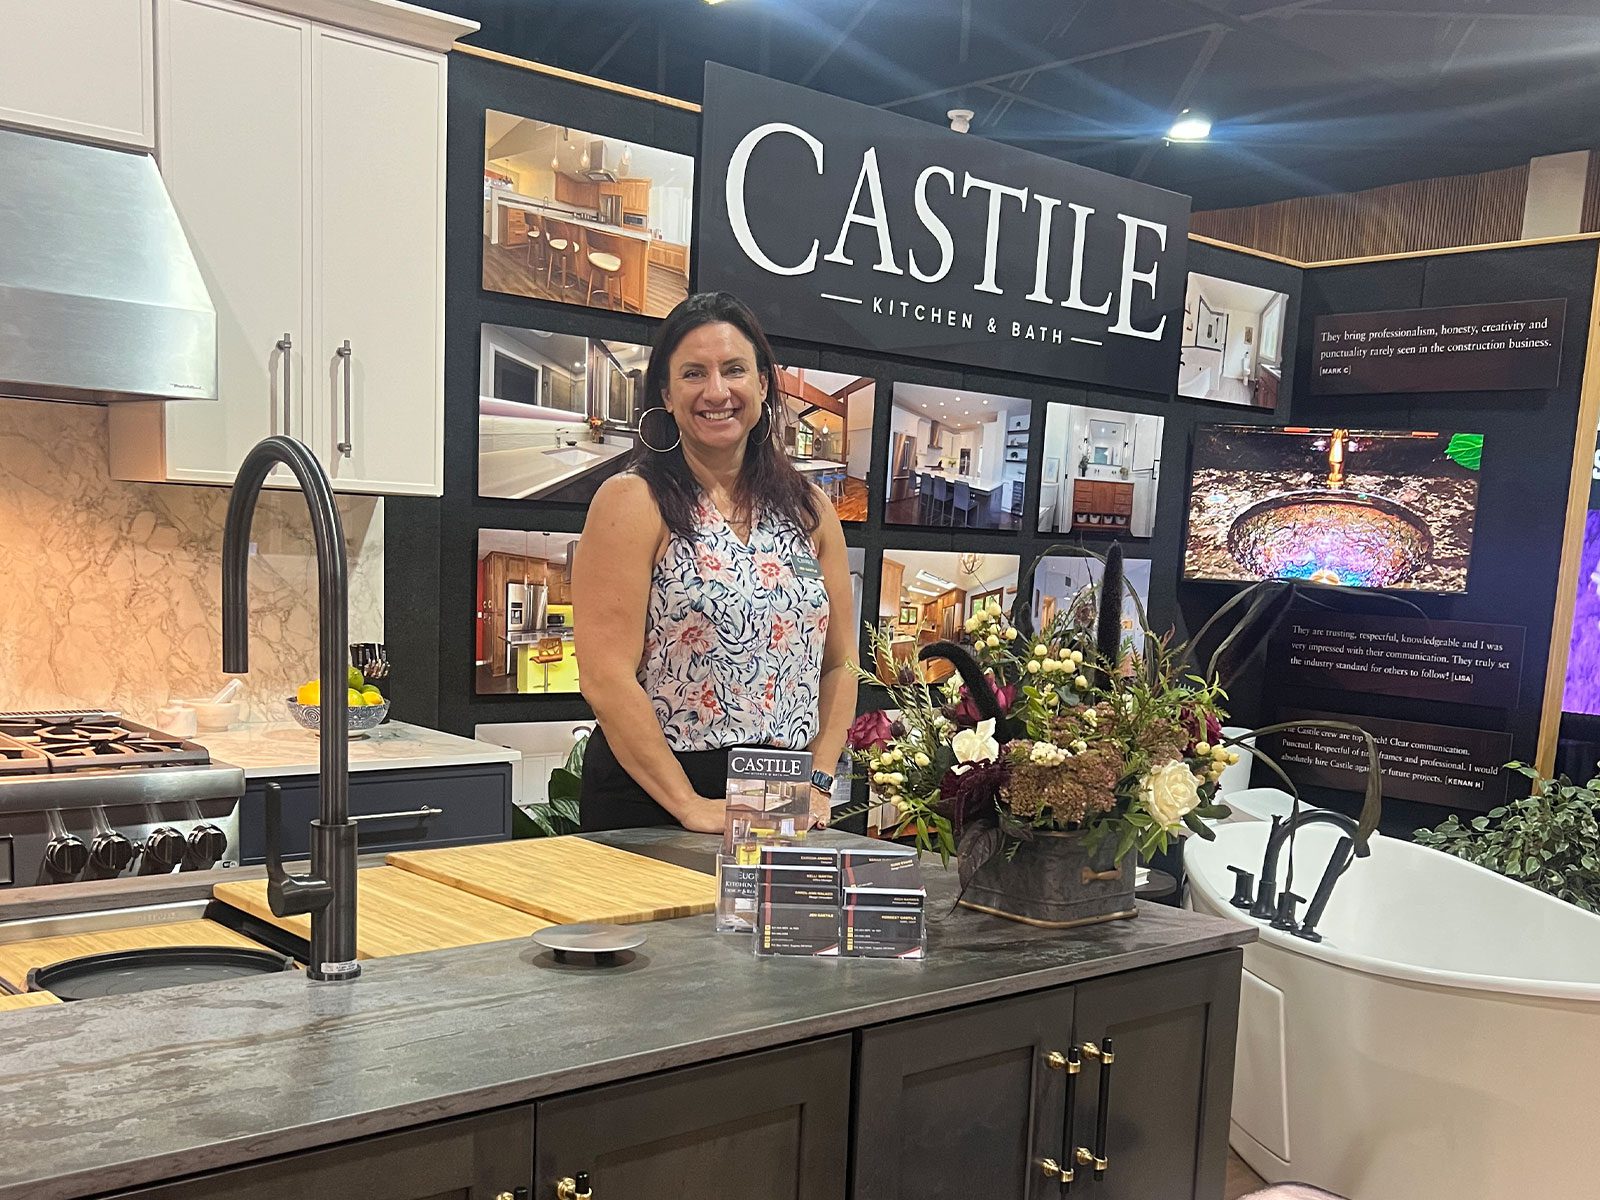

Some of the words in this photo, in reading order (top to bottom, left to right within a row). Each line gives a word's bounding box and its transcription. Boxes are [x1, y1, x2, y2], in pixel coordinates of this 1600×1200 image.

[725, 122, 1167, 342] CASTILE
[873, 296, 973, 329] KITCHEN
[987, 317, 997, 333] &
[1011, 321, 1062, 344] BATH
[1320, 332, 1341, 343] They
[1344, 330, 1366, 342] bring
[1368, 325, 1438, 342] professionalism,
[1441, 324, 1478, 336] honesty,
[1481, 320, 1526, 332] creativity
[1528, 317, 1548, 329] and
[1320, 346, 1367, 360] punctuality
[1370, 345, 1395, 357] rarely
[1397, 346, 1416, 355] seen
[1418, 344, 1428, 353] in
[1430, 342, 1445, 353] the
[1447, 339, 1505, 352] construction
[1509, 337, 1552, 349] business.
[1320, 366, 1342, 376] [MARK
[1292, 625, 1310, 636] They
[1326, 630, 1357, 640] trusting,
[1360, 632, 1399, 643] respectful,
[1401, 634, 1460, 648] knowledgeable
[1462, 640, 1478, 649] and
[1480, 641, 1485, 650] I
[1486, 643, 1503, 651] was
[1291, 643, 1306, 651] very
[1308, 644, 1345, 654] impressed
[1347, 646, 1364, 655] with
[1366, 647, 1384, 657] their
[1385, 650, 1450, 664] communication.
[1452, 655, 1473, 667] They
[1475, 658, 1495, 669] truly
[1498, 661, 1510, 669] set
[1290, 656, 1302, 665] the
[1304, 658, 1334, 670] industry
[1336, 662, 1368, 672] standard
[1370, 663, 1382, 673] for
[1383, 665, 1408, 676] others
[1410, 669, 1419, 677] to
[1421, 668, 1450, 680] follow!
[1451, 672, 1474, 684] [LISA]
[1297, 727, 1320, 736] Castile
[1321, 730, 1338, 738] crew
[1352, 734, 1364, 743] top
[1389, 738, 1409, 748] Clear
[1410, 742, 1470, 755] communication.
[731, 757, 802, 776] CASTILE
[1282, 739, 1313, 750] Punctual.
[1315, 743, 1350, 755] Respectful
[1352, 748, 1360, 756] of
[1378, 751, 1402, 762] frames
[1404, 756, 1418, 764] and
[1420, 758, 1466, 771] professional.
[1468, 763, 1472, 772] I
[1474, 766, 1499, 775] would
[1281, 753, 1313, 765] absolutely
[1315, 757, 1328, 767] hire
[1330, 760, 1353, 770] Castile
[1354, 765, 1370, 773] agai
[1388, 767, 1411, 778] future
[1412, 773, 1442, 783] projects.
[1445, 776, 1473, 787] [KENAN
[1475, 780, 1484, 790] H]
[738, 871, 755, 880] EUG
